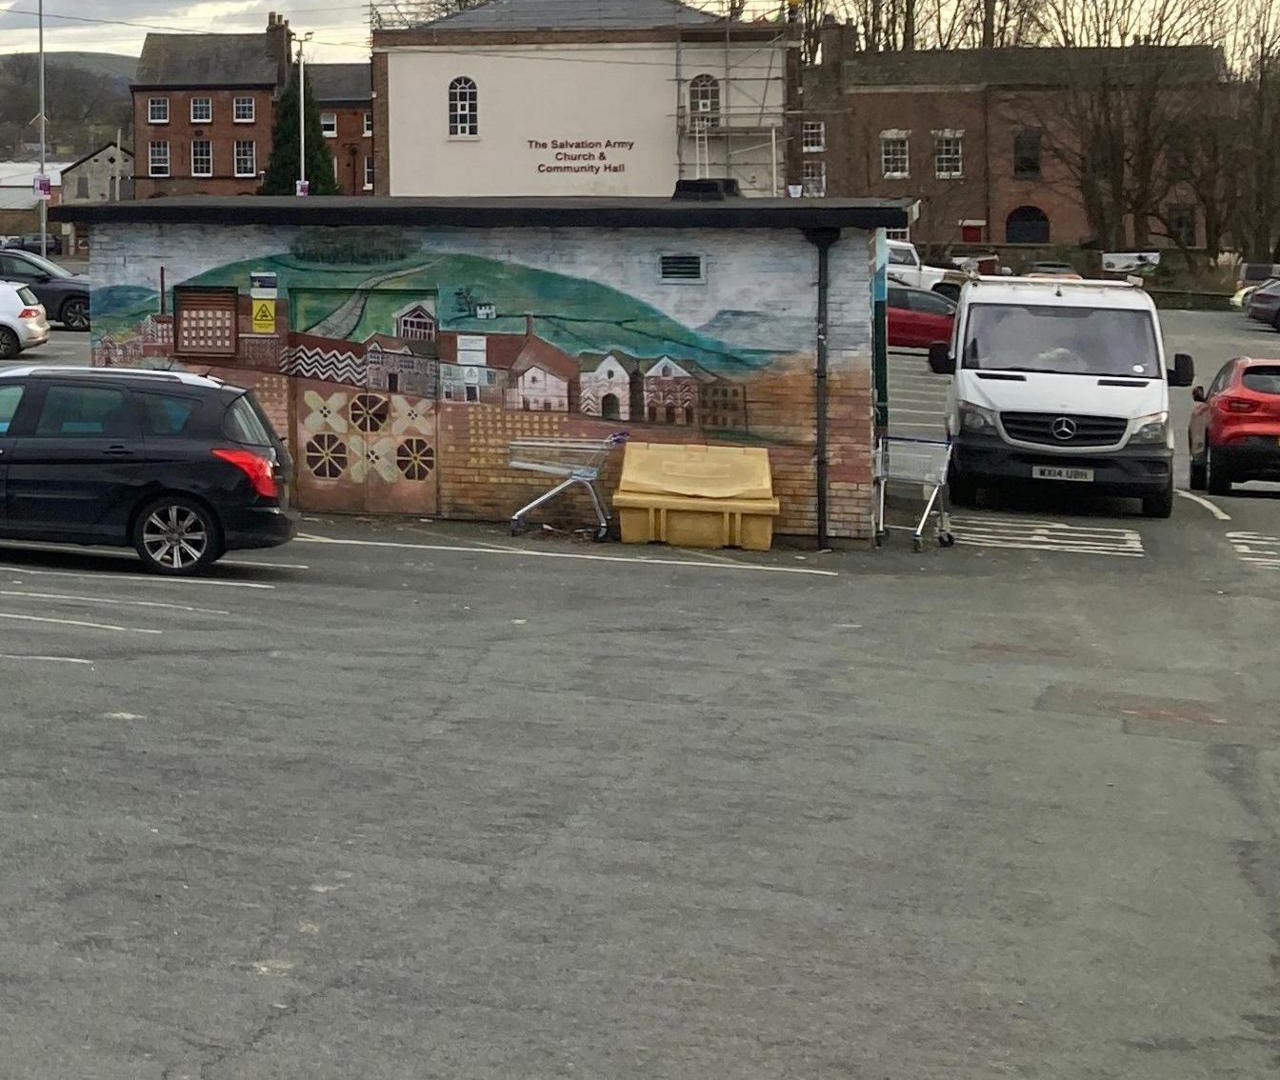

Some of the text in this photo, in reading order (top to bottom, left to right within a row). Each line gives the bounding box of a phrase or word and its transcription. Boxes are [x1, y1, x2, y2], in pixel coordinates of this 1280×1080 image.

[527, 139, 635, 151] The Salvation Army
[555, 151, 607, 161] Church &
[537, 163, 625, 175] Community Hall
